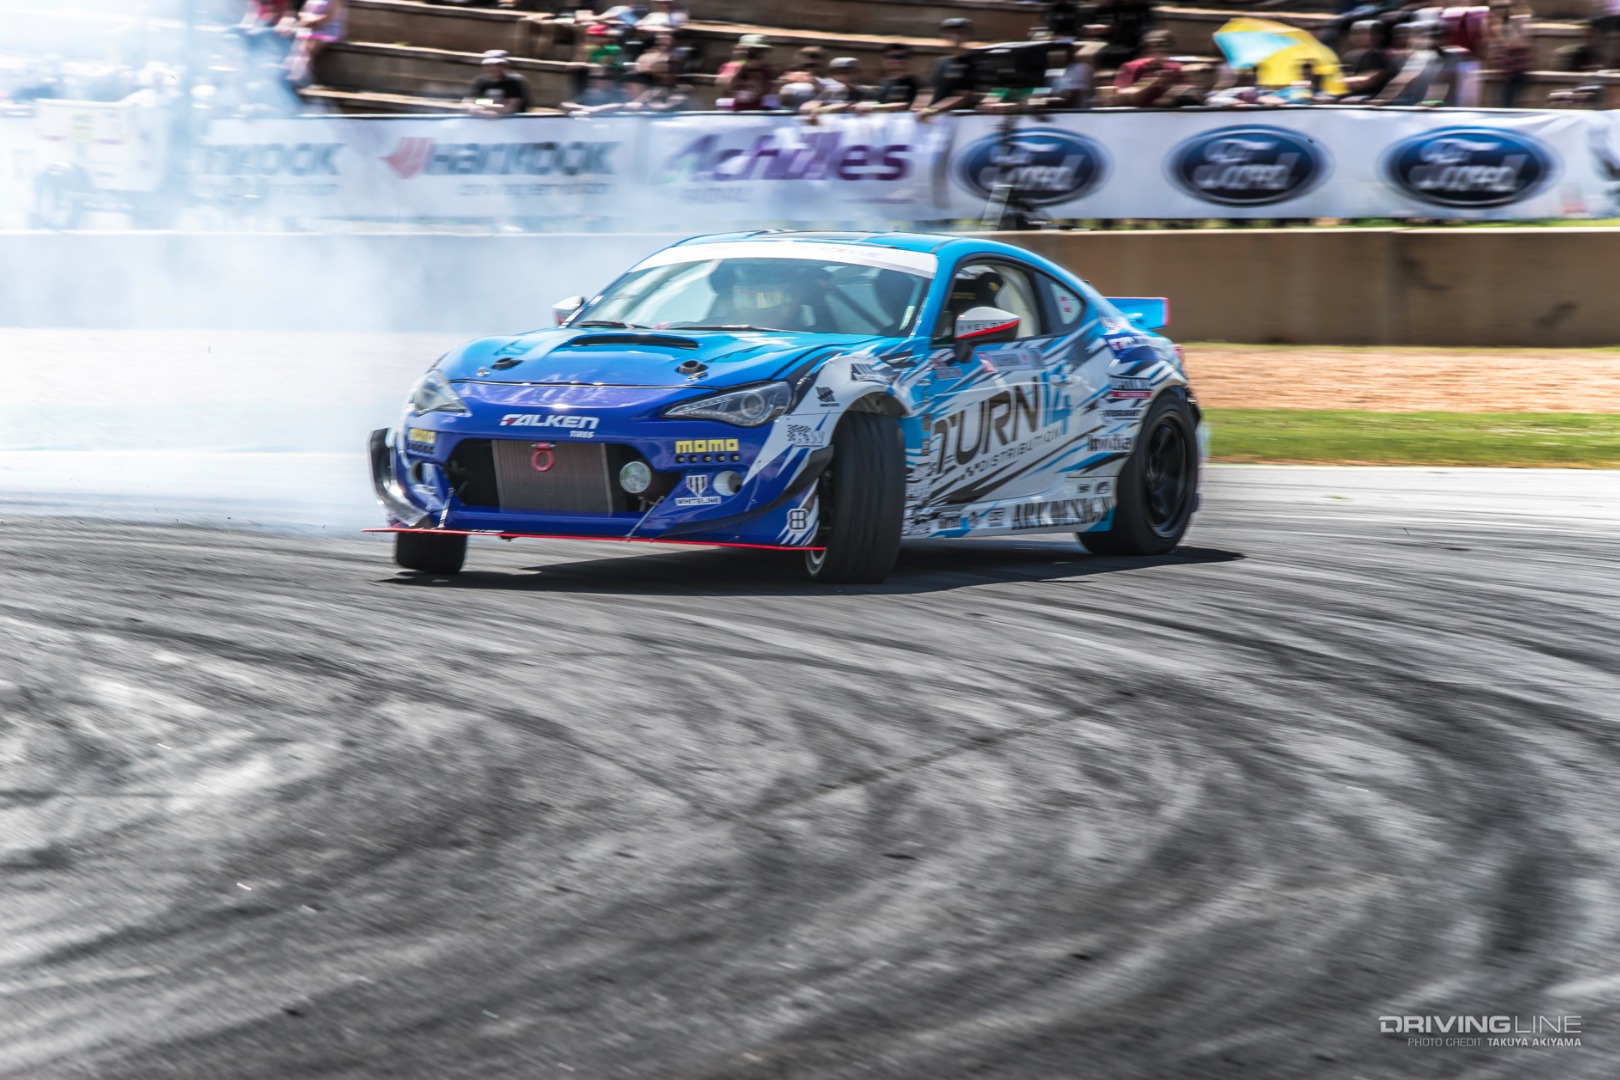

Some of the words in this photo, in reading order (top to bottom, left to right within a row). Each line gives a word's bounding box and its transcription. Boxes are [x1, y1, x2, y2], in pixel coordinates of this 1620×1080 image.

[1190, 138, 1303, 191] Ford
[1407, 138, 1530, 192] Ford
[499, 413, 600, 430] FALKEN
[569, 430, 595, 439] TIRES
[978, 427, 1063, 474] DISTRIBUTION
